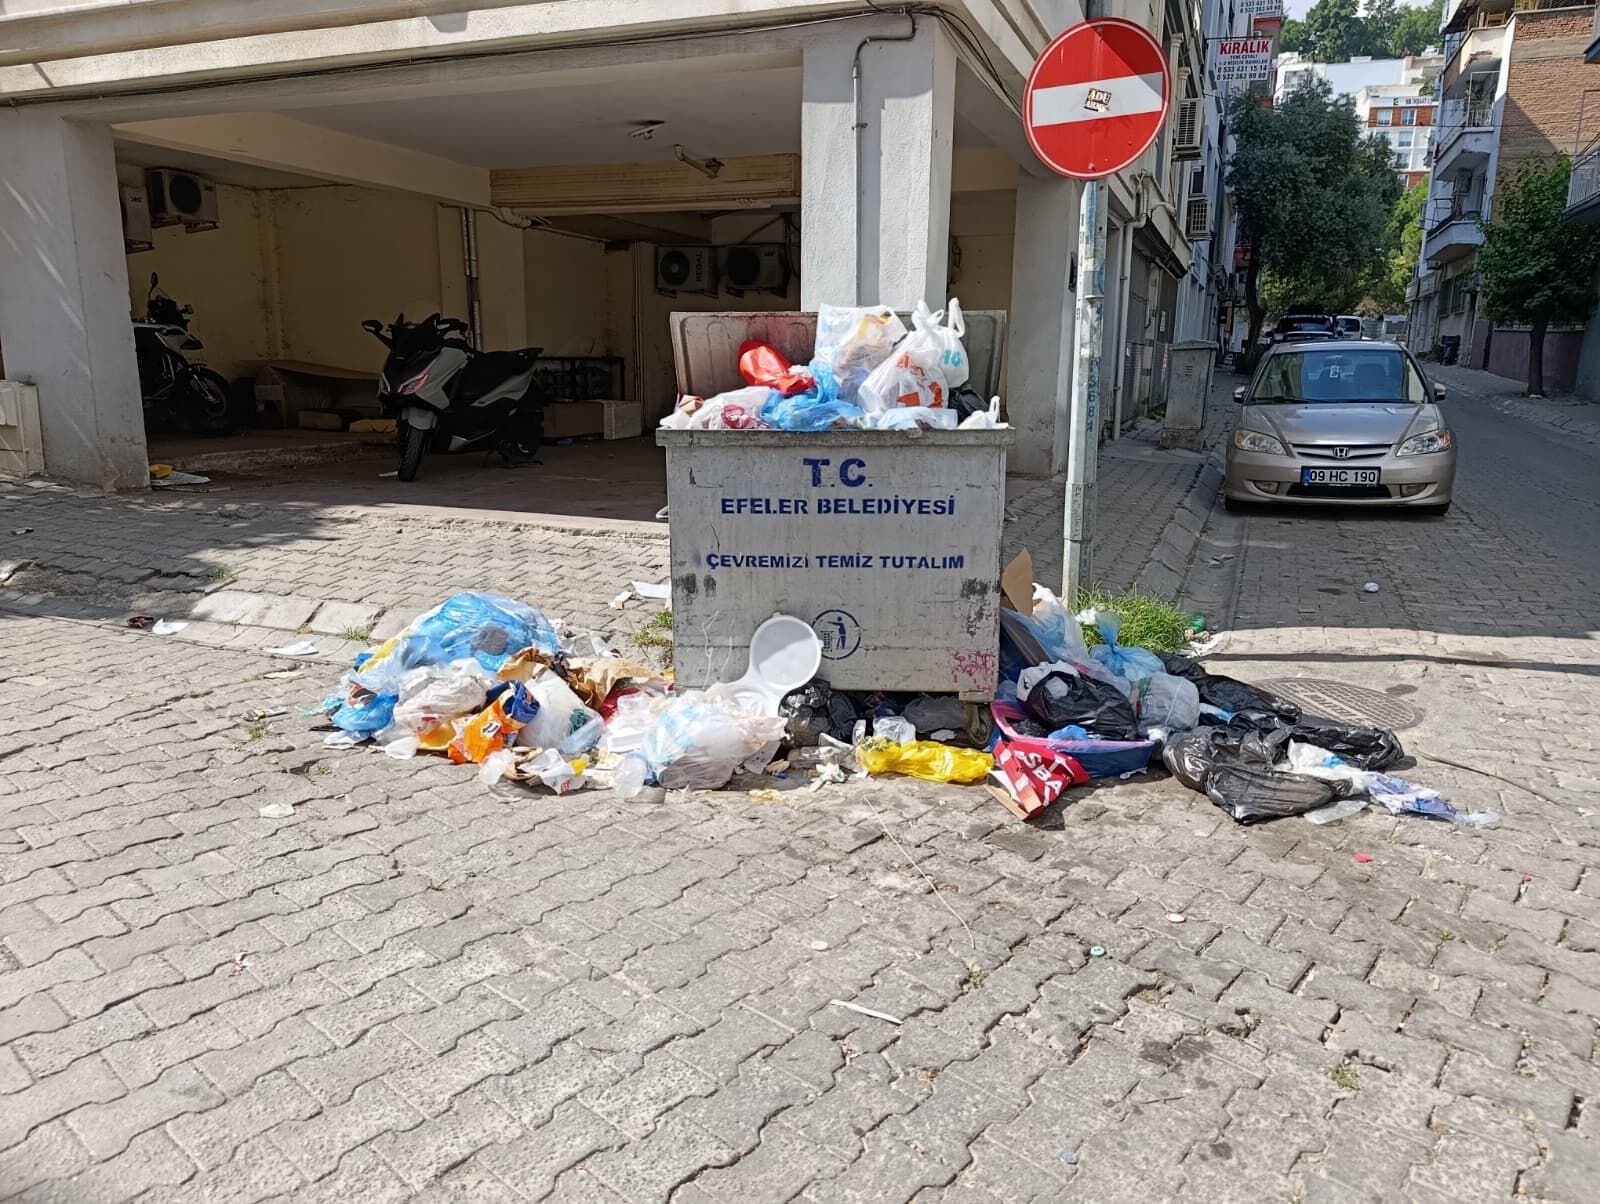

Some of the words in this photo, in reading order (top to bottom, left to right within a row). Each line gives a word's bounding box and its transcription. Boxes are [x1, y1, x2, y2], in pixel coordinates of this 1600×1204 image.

[803, 458, 872, 487] T.C.
[1310, 470, 1326, 482] 09
[1329, 470, 1348, 482] HC
[1354, 471, 1376, 483] 190
[721, 498, 808, 514] EFELER
[817, 495, 955, 515] BELEDİYESİ
[706, 553, 809, 570] ÇEVREMİZİ
[816, 552, 873, 569] TEMİZ
[879, 554, 965, 569] TUTALIM
